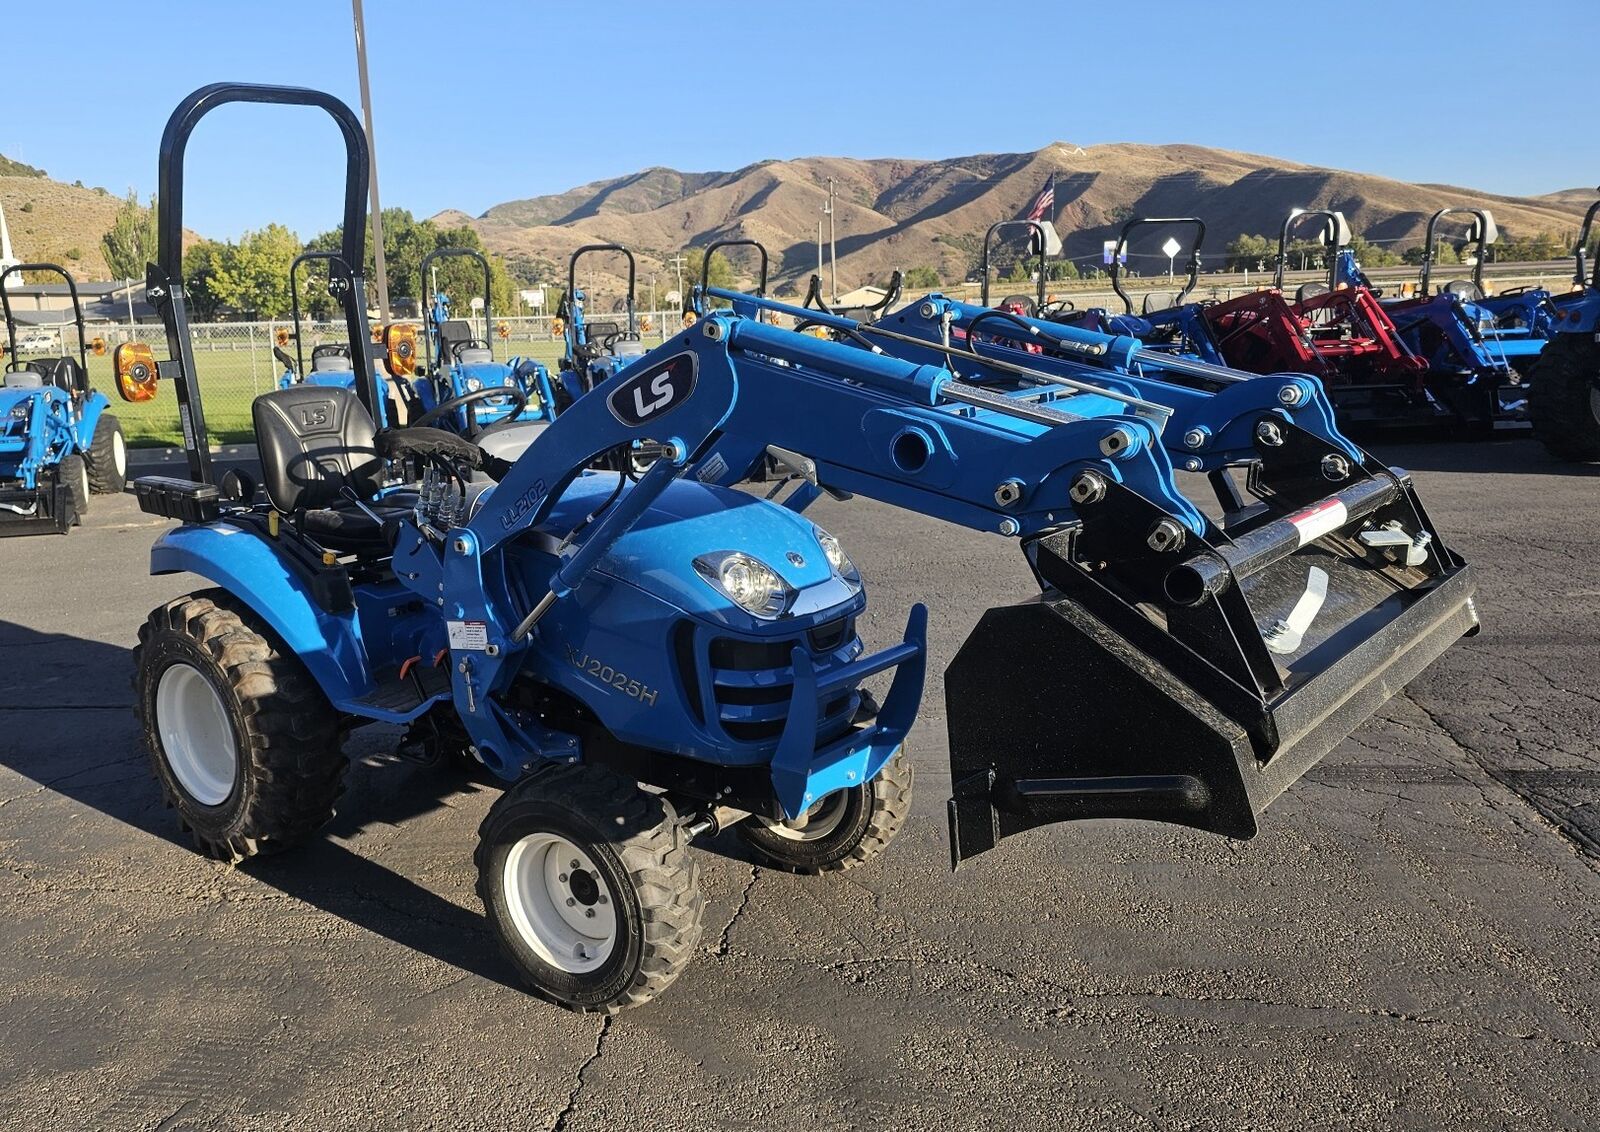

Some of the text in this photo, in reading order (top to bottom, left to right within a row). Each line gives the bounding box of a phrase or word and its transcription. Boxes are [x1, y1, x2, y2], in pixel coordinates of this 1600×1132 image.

[301, 409, 327, 426] LS
[633, 370, 674, 418] LS
[500, 478, 547, 531] LL2102
